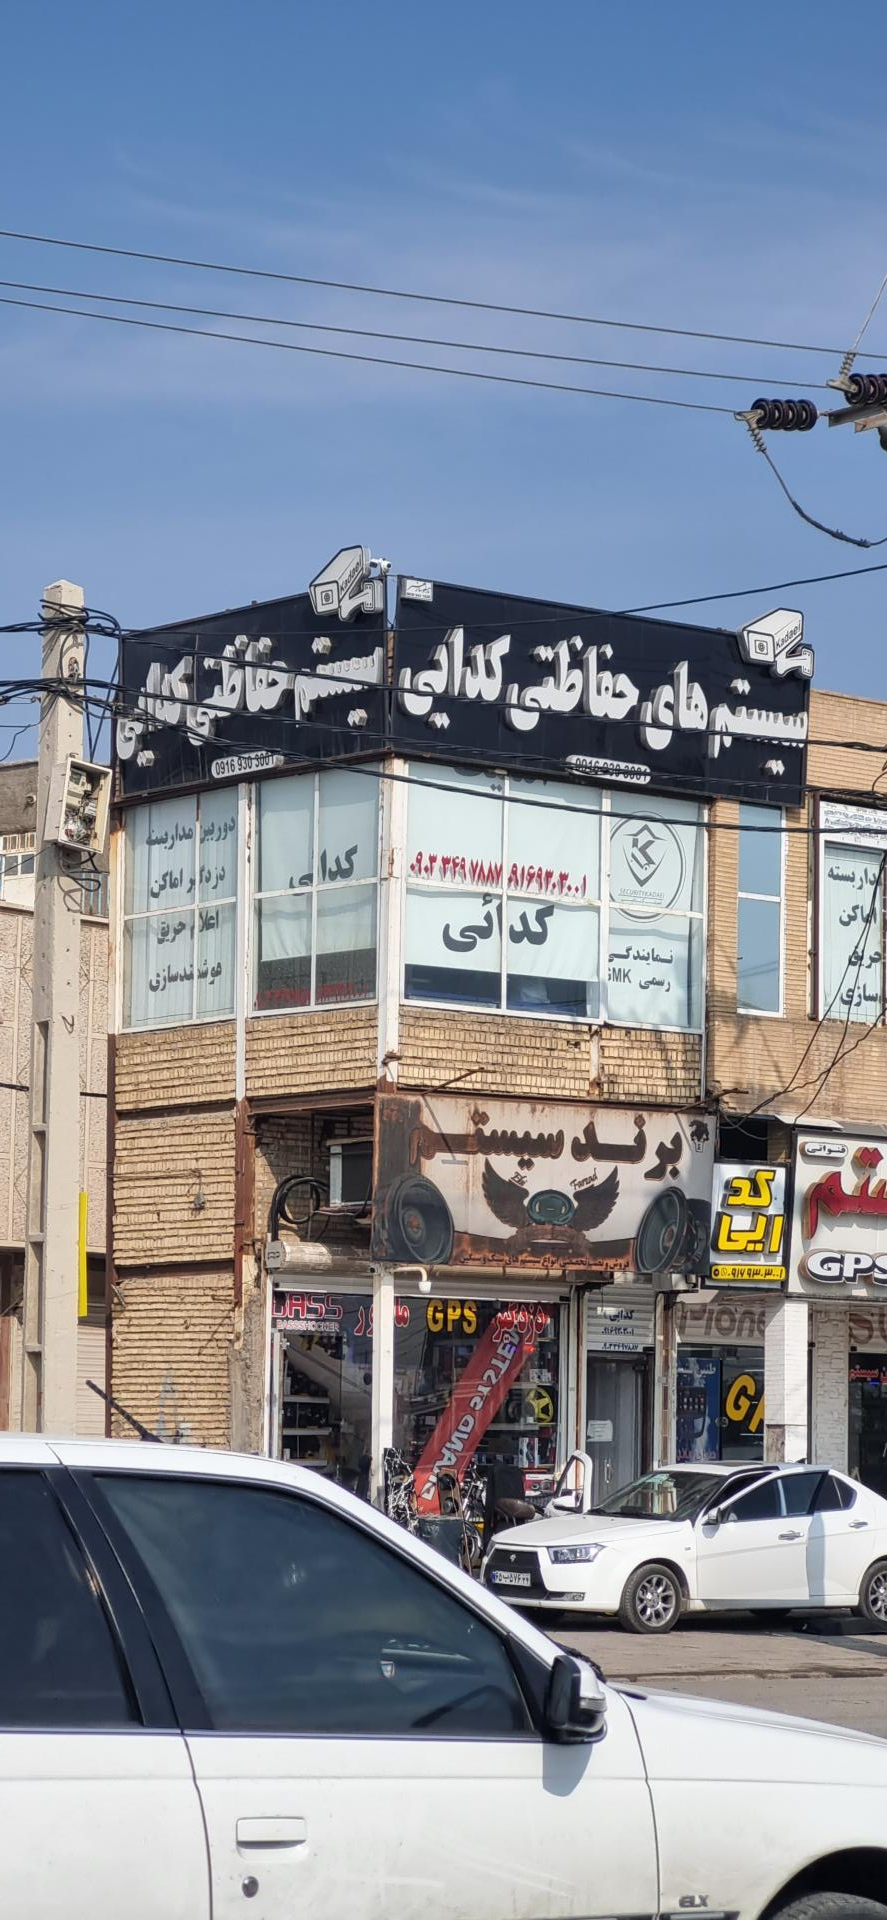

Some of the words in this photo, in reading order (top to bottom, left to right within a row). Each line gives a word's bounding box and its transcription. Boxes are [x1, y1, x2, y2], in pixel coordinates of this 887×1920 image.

[776, 619, 801, 651] Kadaei
[506, 635, 639, 731] حفاظتی
[640, 660, 709, 750] های
[709, 678, 809, 777] سیستم
[215, 759, 235, 775] 0916
[150, 868, 183, 898] اماکن
[156, 919, 186, 944] حریق
[149, 959, 222, 993] هوشندسازی
[638, 976, 671, 993] رسمی
[409, 1109, 565, 1171] سیستم
[570, 1112, 684, 1182] برند
[426, 1298, 478, 1335] GPS
[678, 1895, 709, 1908] ELX
